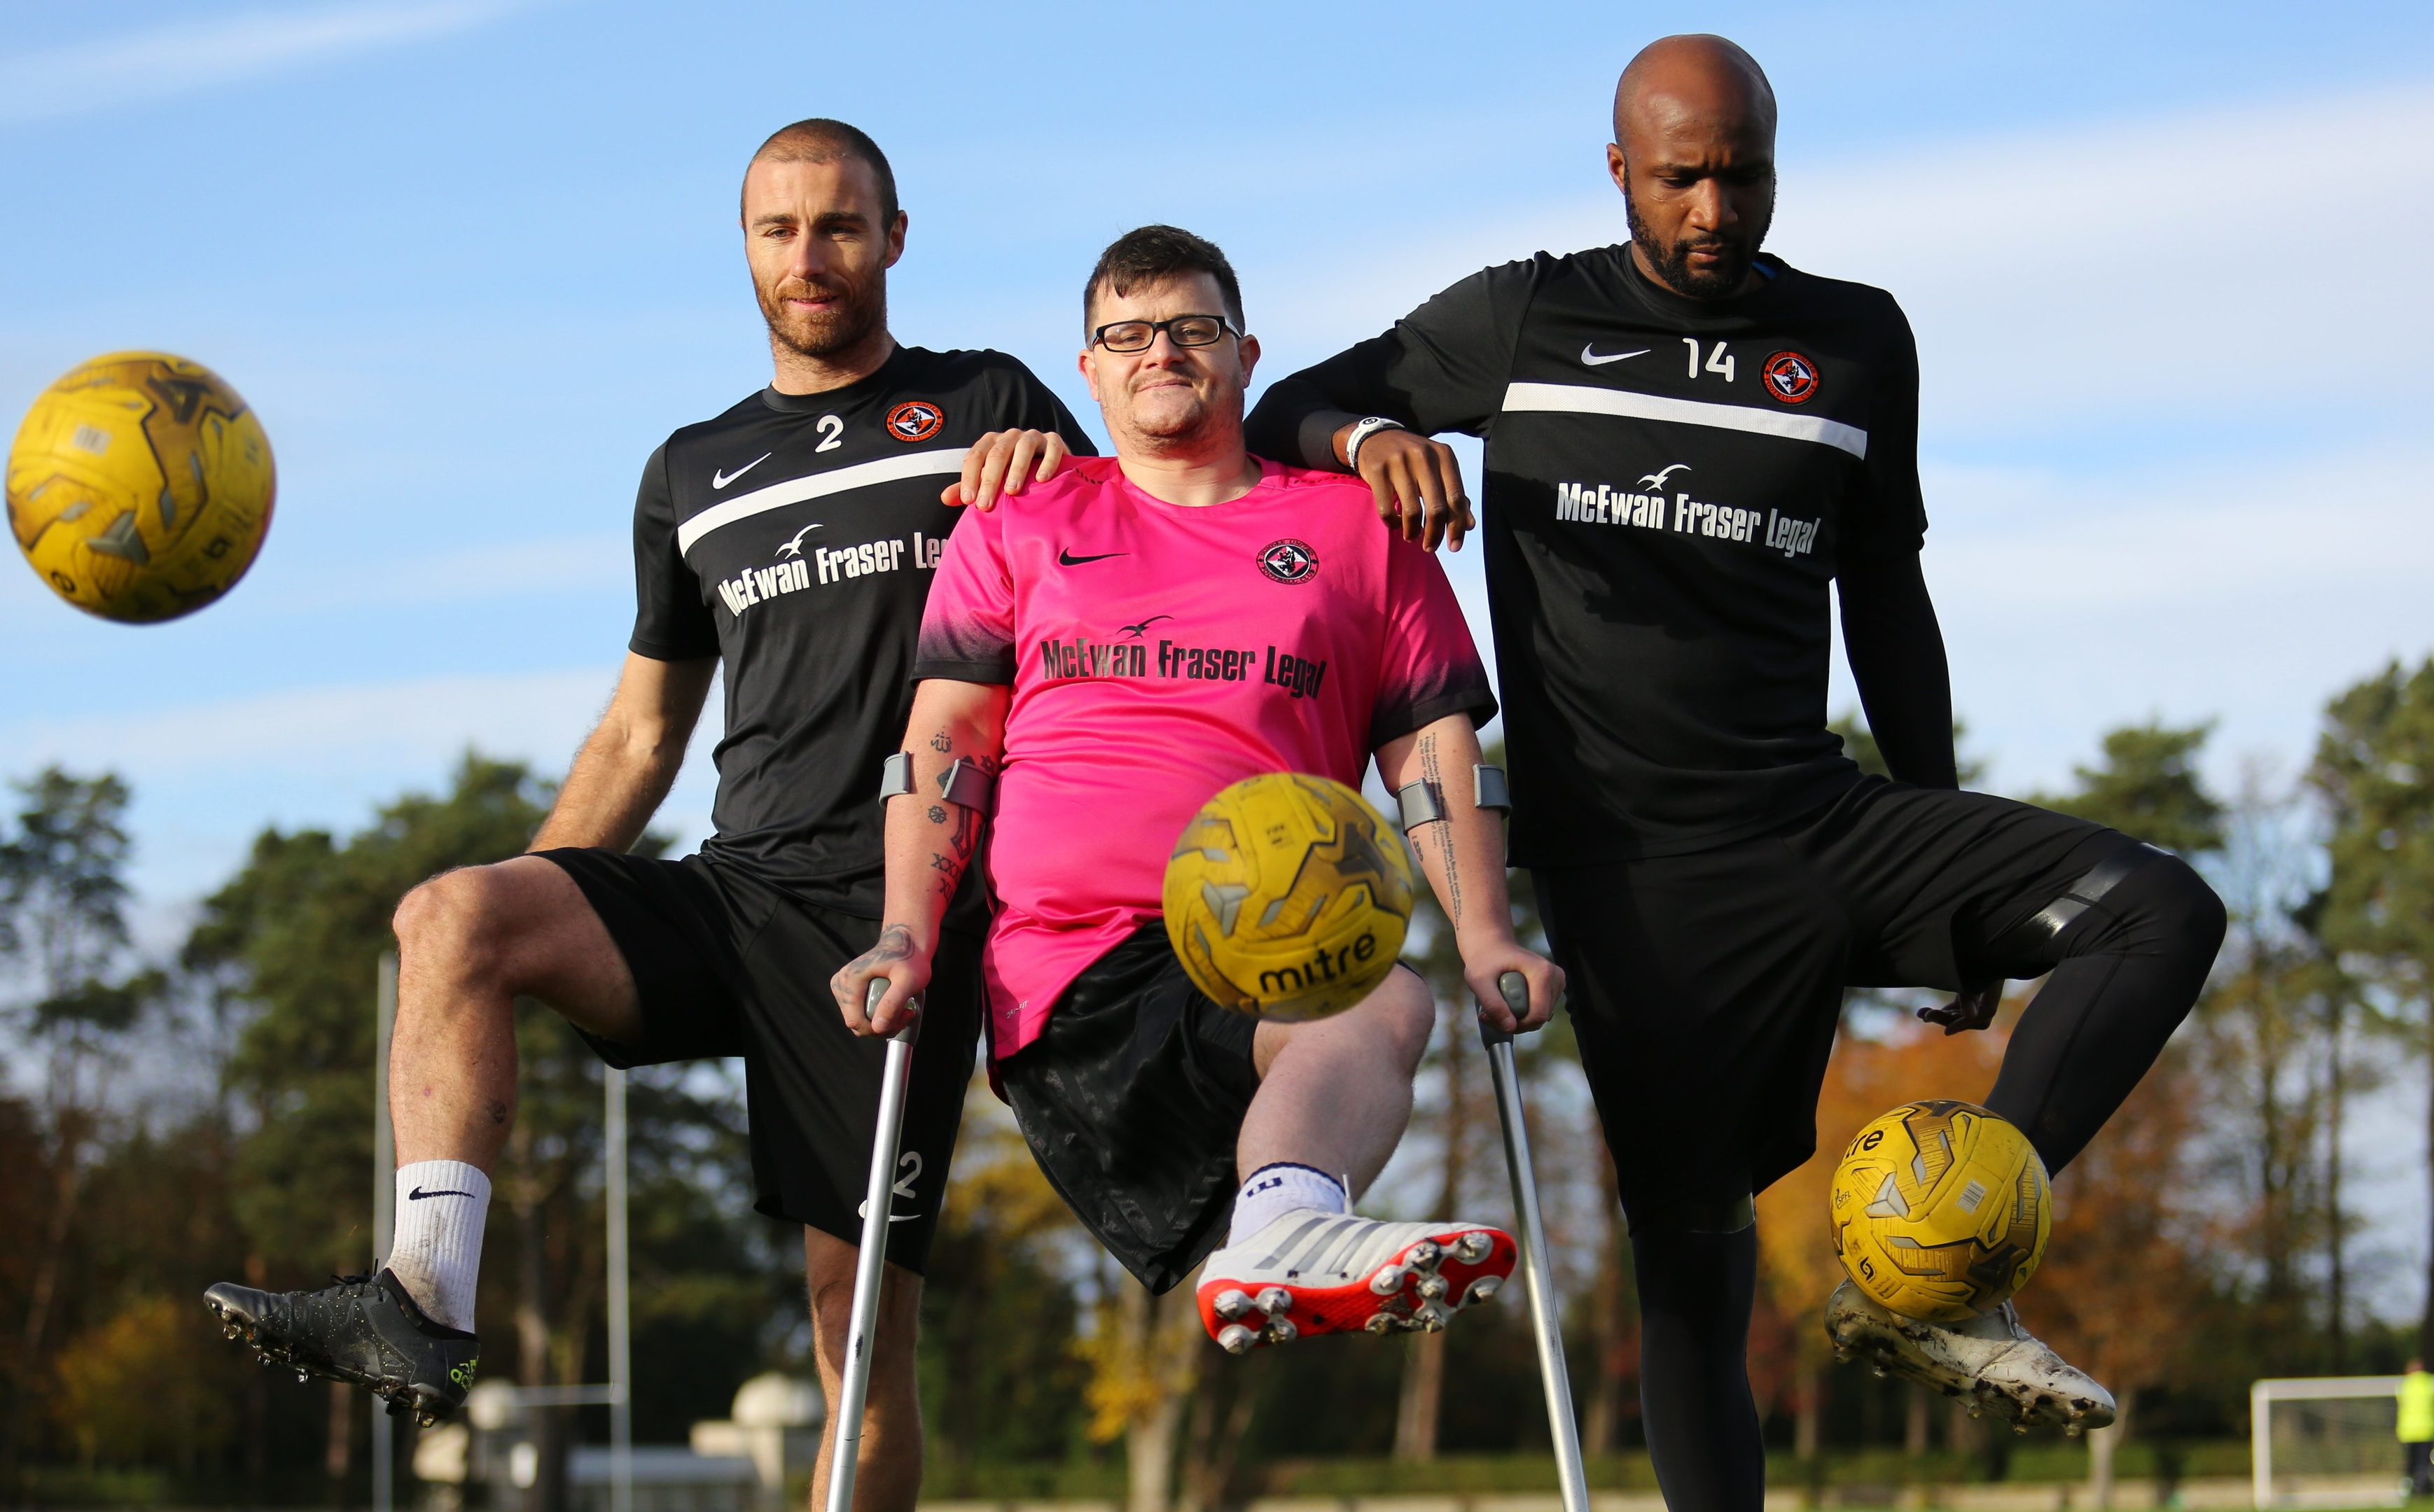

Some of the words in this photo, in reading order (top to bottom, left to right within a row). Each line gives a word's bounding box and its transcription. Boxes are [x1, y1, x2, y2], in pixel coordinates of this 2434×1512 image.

[1683, 337, 1735, 382] 14
[814, 415, 844, 452] 2
[1556, 482, 1665, 530] McEwan
[1674, 493, 1761, 543] Fraser
[1765, 508, 1821, 558] Legal
[718, 559, 811, 617] McEwan
[815, 538, 905, 584] Fraser
[913, 532, 949, 568] Le
[1041, 638, 1147, 680] McEwan
[1157, 640, 1256, 682] Fraser
[1264, 645, 1328, 700] Legal
[1259, 932, 1376, 993] mitre
[893, 1151, 923, 1199] 2
